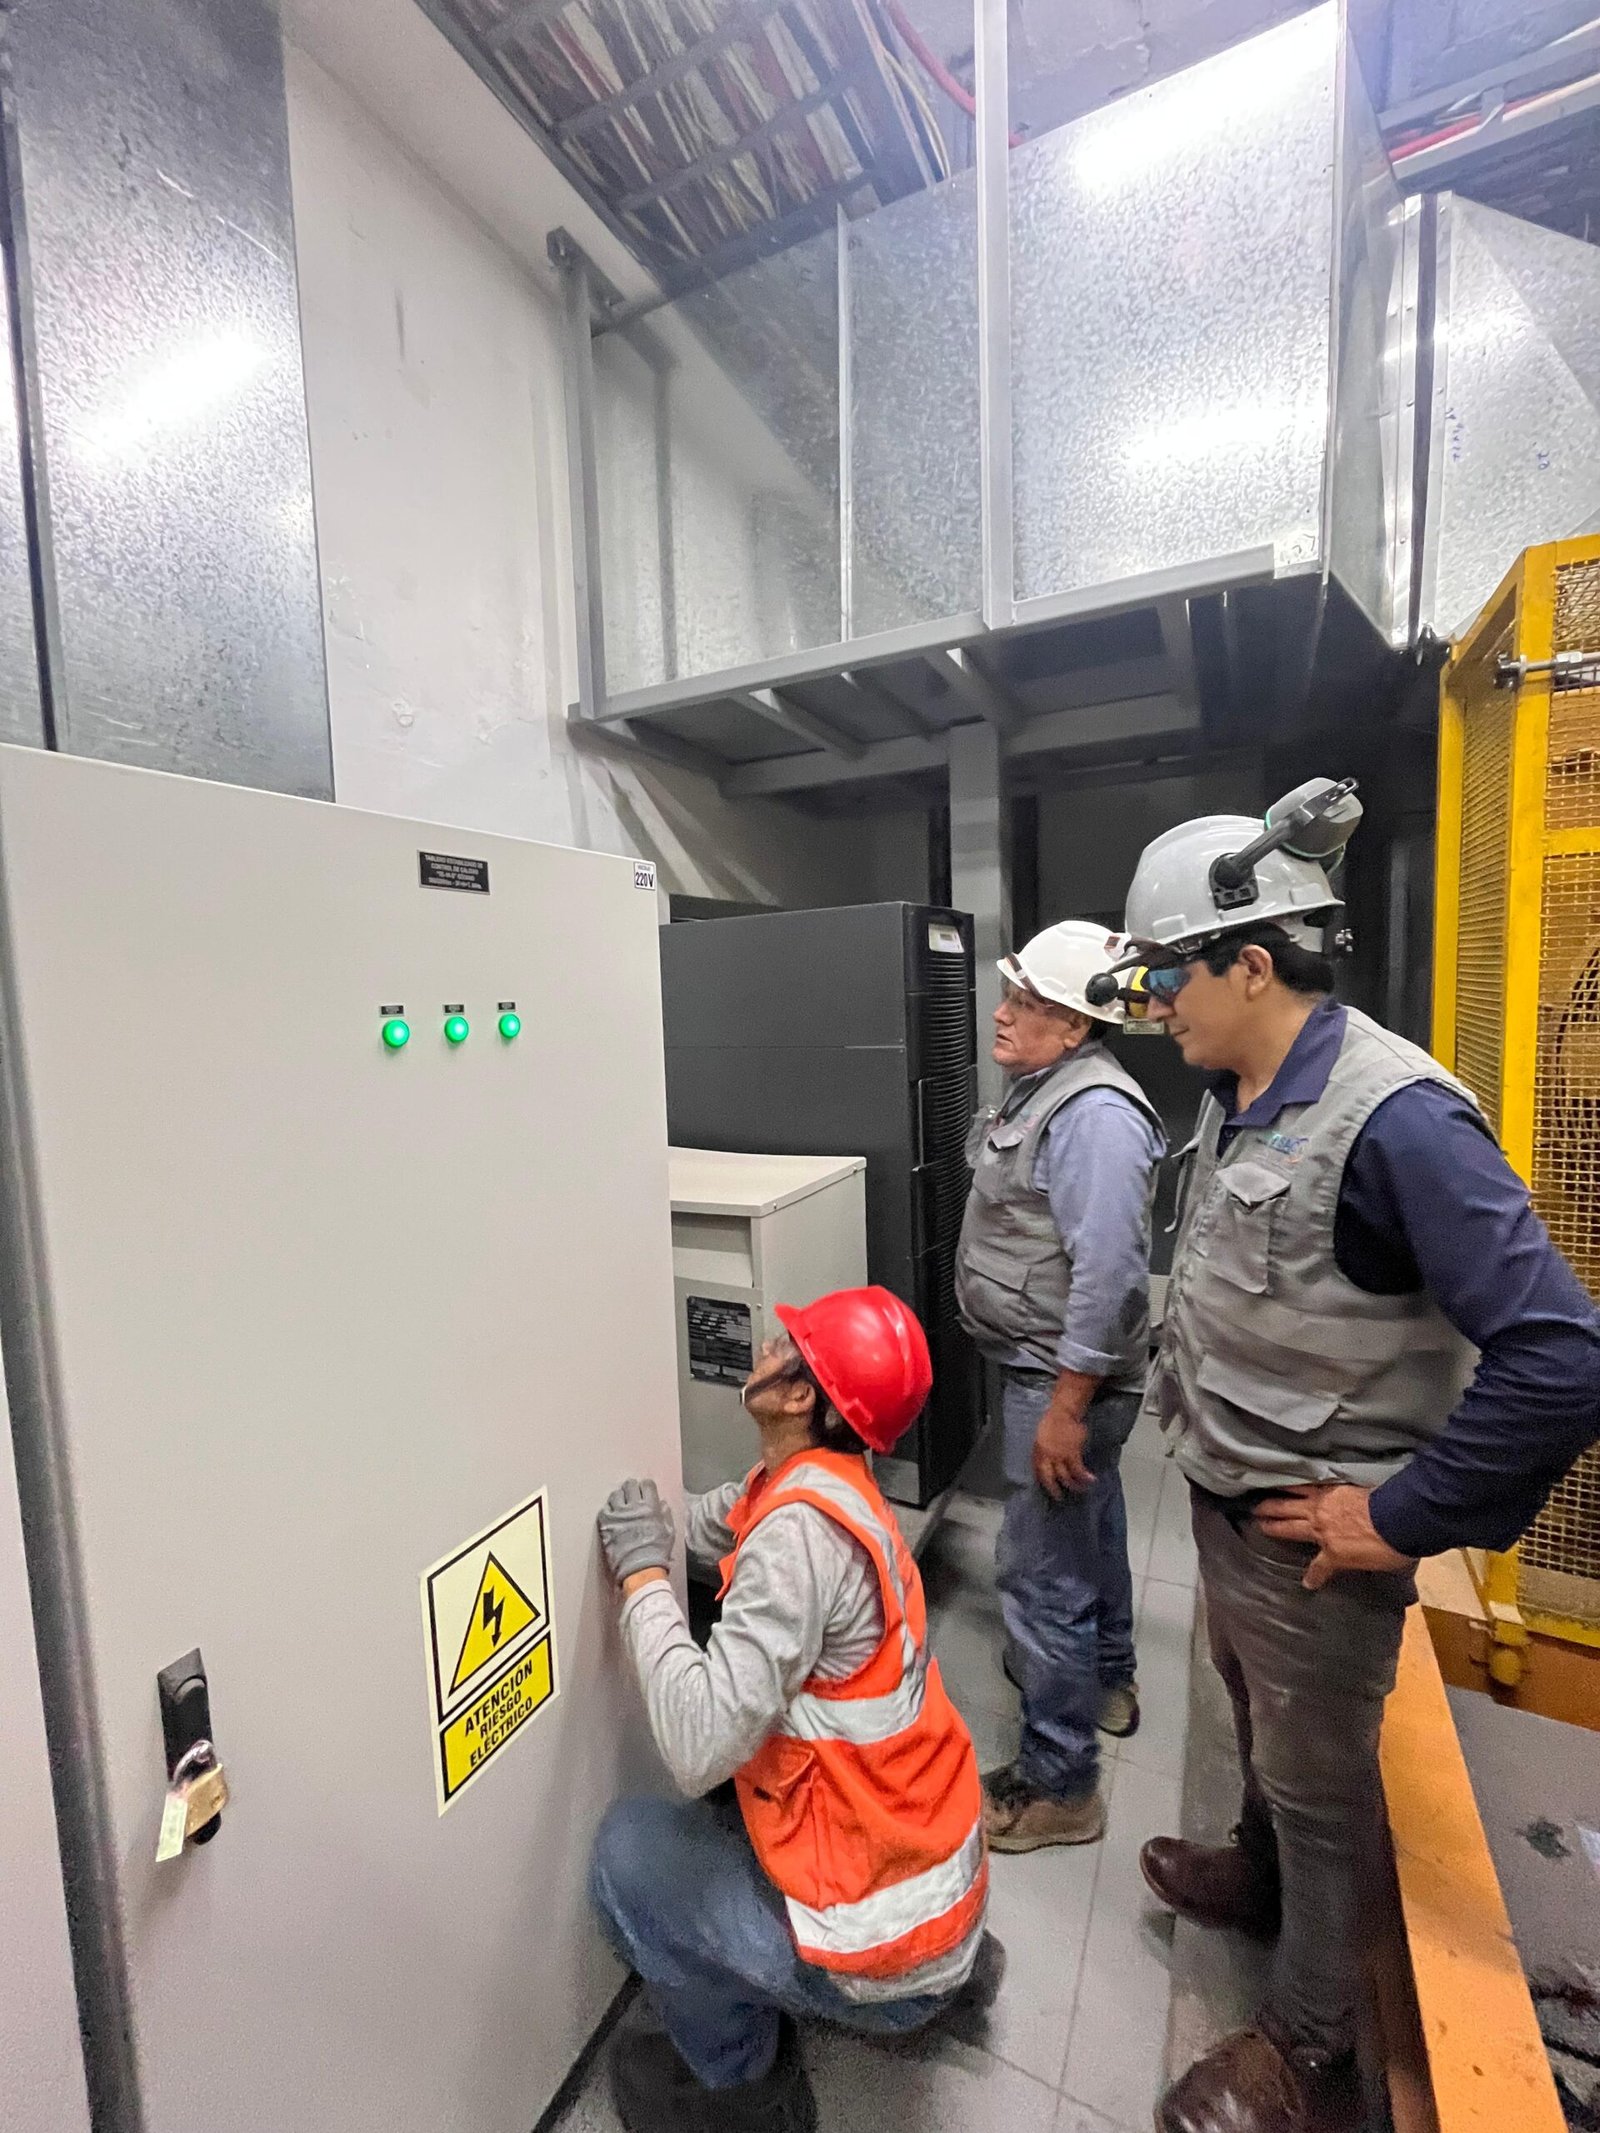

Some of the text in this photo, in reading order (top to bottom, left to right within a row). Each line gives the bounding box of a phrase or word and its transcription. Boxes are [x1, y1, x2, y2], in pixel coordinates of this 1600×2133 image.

[465, 1659, 533, 1737] ATENCIÓN
[470, 1696, 533, 1767] ELÉCTRICO
[480, 1690, 522, 1738] RIESGO
